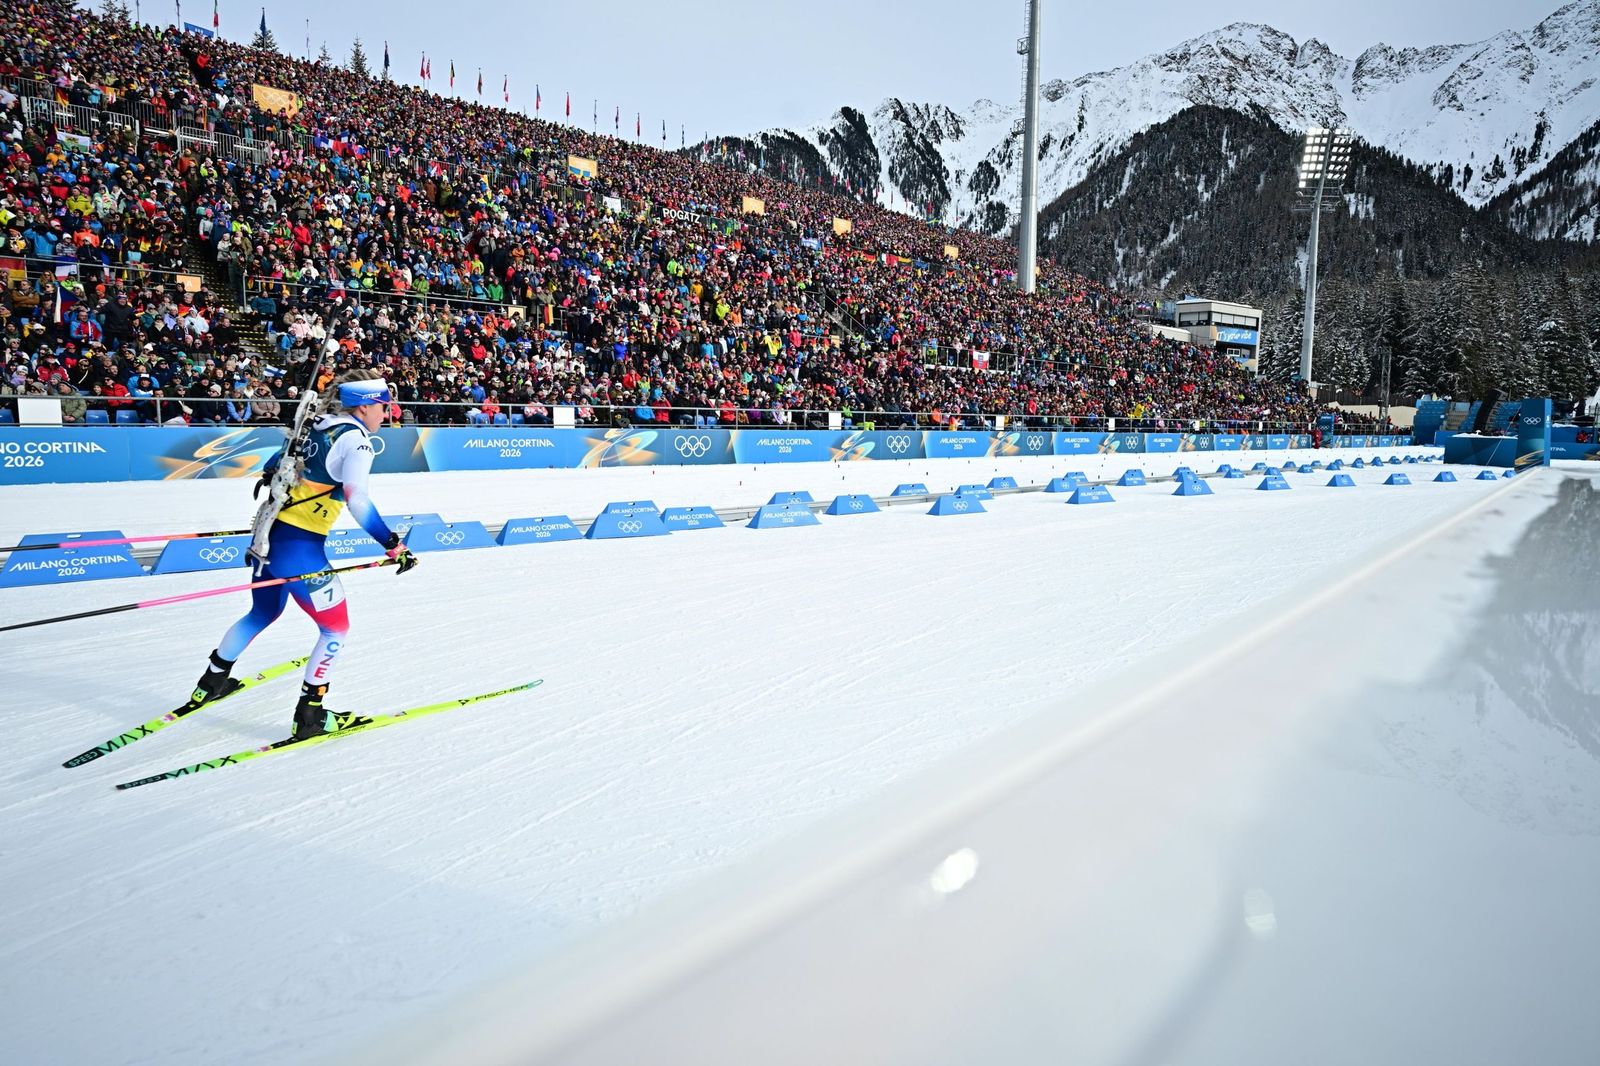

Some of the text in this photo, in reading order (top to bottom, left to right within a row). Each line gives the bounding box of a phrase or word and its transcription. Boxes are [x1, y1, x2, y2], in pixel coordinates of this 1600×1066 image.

[24, 442, 107, 454] CORTINA
[463, 439, 555, 448] MILANO CORTINA
[756, 438, 813, 446] MILANO CORTINA
[499, 448, 522, 457] 2026
[4, 455, 45, 468] 2026
[312, 502, 324, 514] 7
[510, 523, 573, 534] MILANO CORTINA
[343, 537, 379, 546] CORTIN
[9, 554, 129, 572] MILANO CORTINA
[57, 567, 86, 577] 2026
[323, 587, 333, 602] 7
[314, 641, 339, 679] CZE
[475, 684, 529, 701] FISCHER
[98, 724, 154, 753] MAX
[165, 755, 238, 778] MAX
